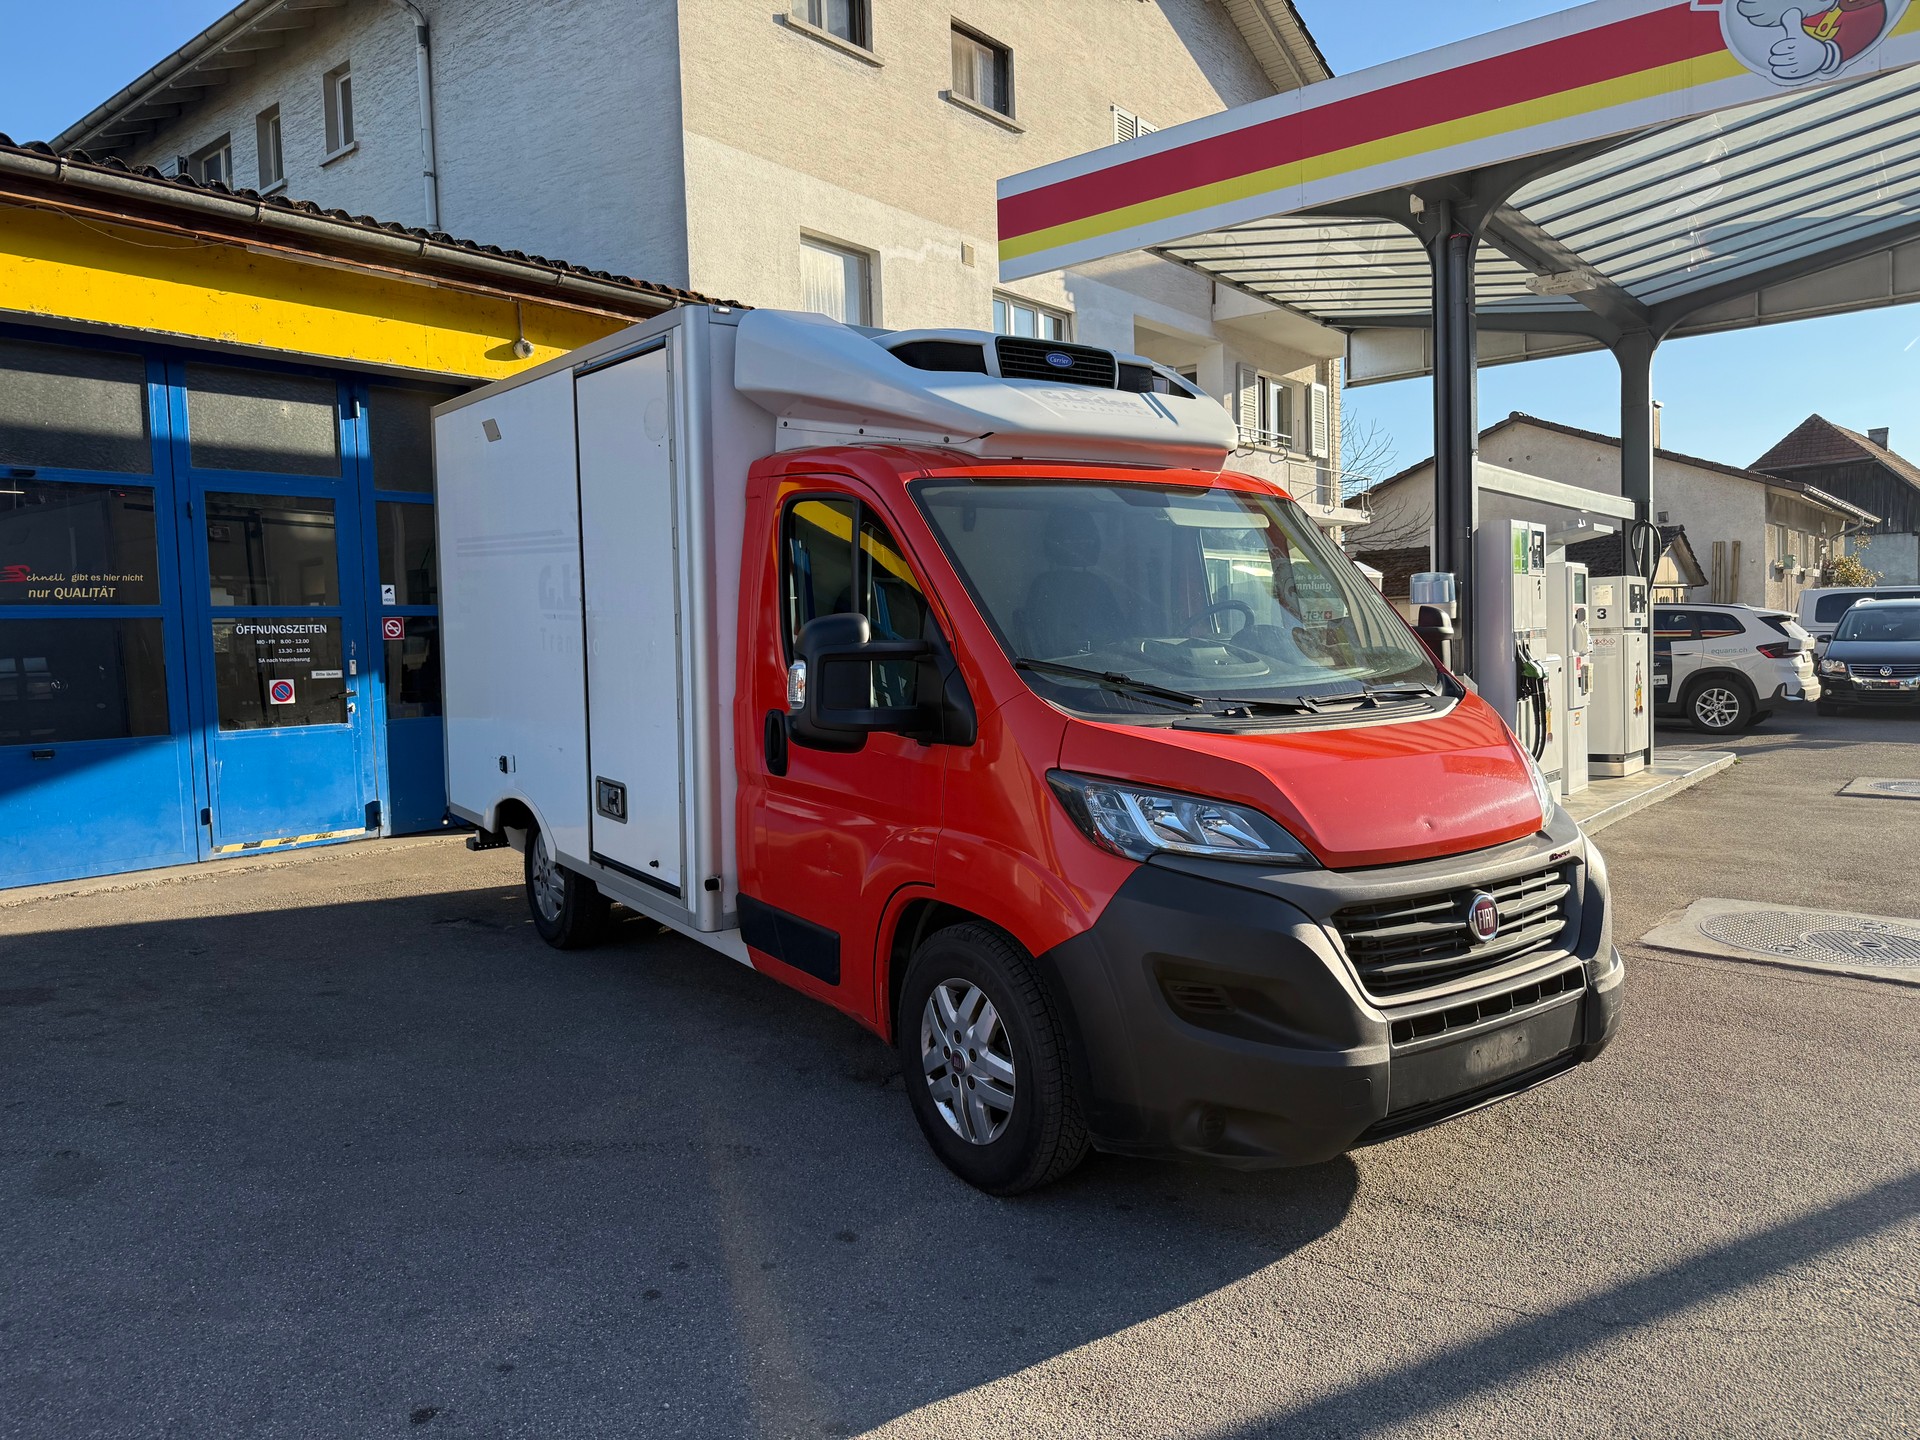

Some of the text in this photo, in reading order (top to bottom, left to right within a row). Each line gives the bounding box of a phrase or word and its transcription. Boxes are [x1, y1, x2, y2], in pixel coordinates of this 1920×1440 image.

[1050, 356, 1069, 365] Carrier
[71, 573, 88, 583] gibt
[103, 573, 120, 581] hier
[122, 573, 144, 582] nicht
[28, 586, 116, 599] nur QUALITÄT
[1596, 608, 1607, 620] 3
[236, 623, 328, 635] ÖFFNUNGSZEITEN
[1711, 647, 1748, 655] equans.ch
[1477, 907, 1494, 930] FIAT
